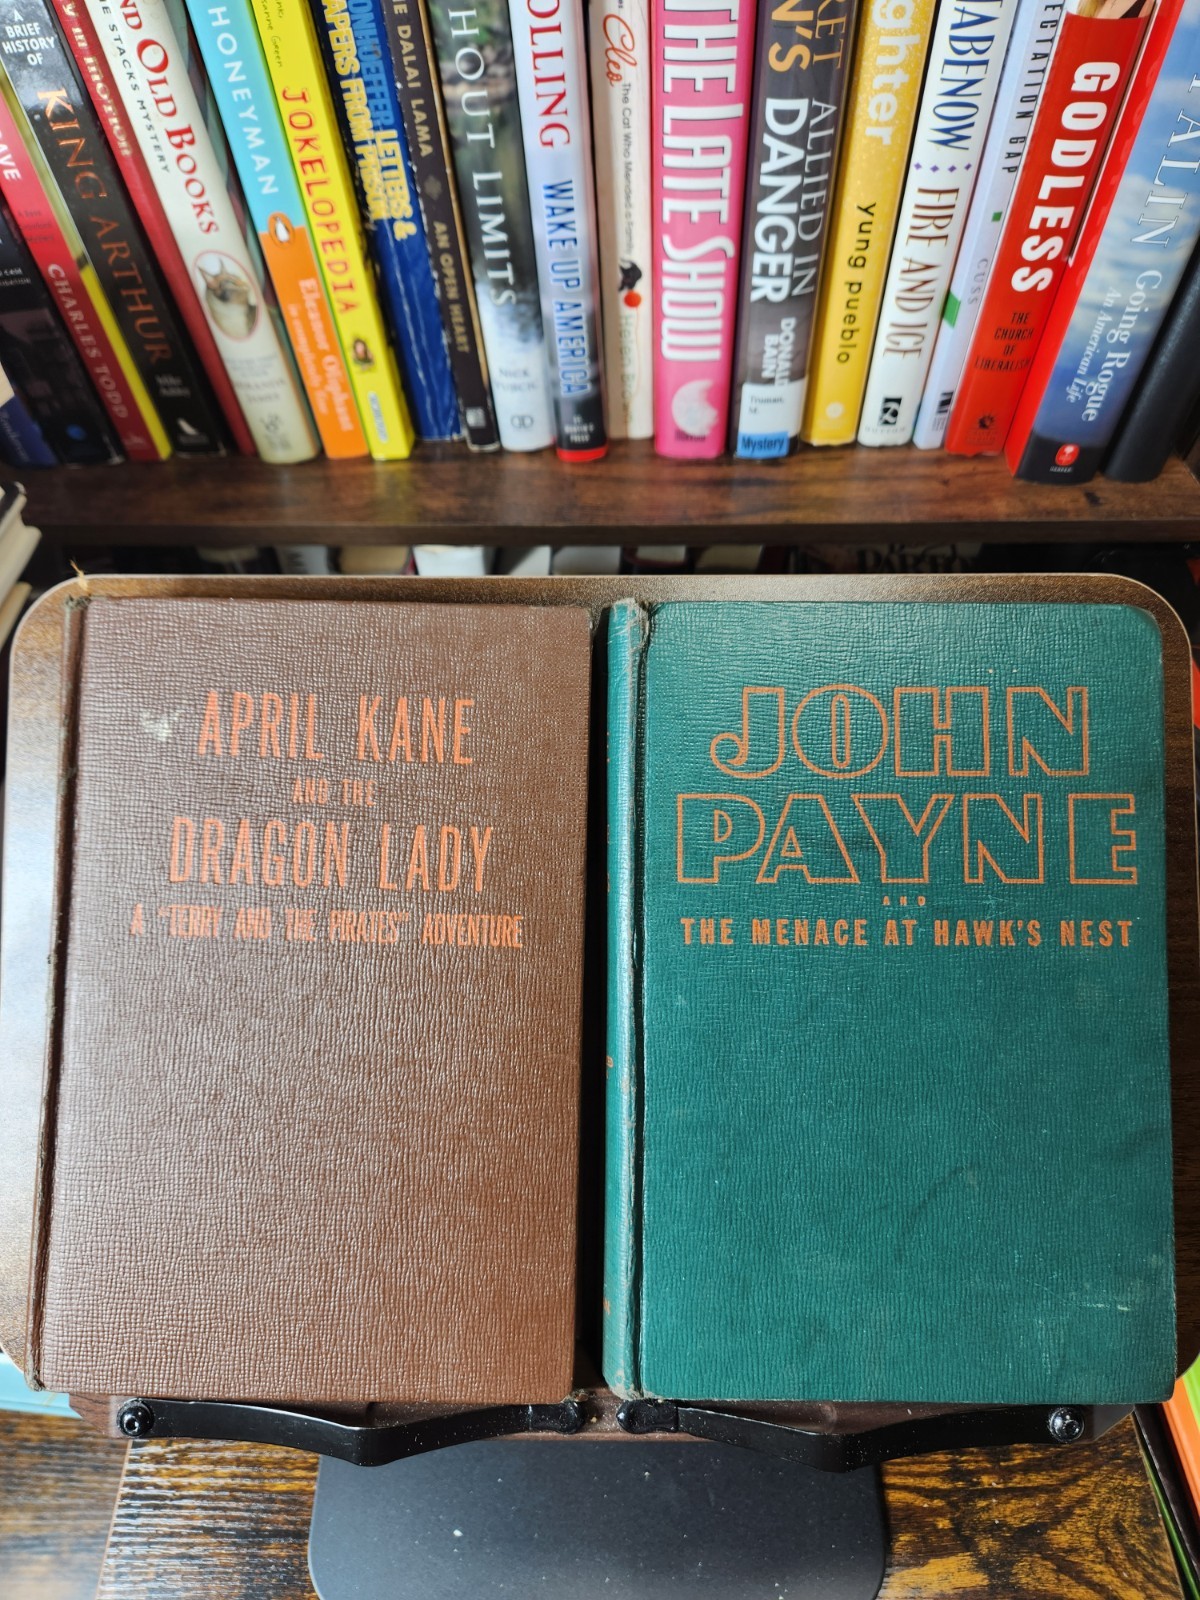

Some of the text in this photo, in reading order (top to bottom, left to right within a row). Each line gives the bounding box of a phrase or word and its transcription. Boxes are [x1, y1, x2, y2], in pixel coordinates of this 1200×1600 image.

[2, 36, 55, 54] HISTORY
[4, 22, 41, 38] BRIEF
[14, 9, 23, 21] A
[26, 53, 43, 66] OF
[270, 35, 283, 67] Green
[397, 24, 421, 89] DALAI
[602, 13, 637, 87] Cleo
[663, 0, 740, 93] THE
[865, 0, 920, 146] ghter
[109, 24, 140, 91] STACKS
[137, 99, 170, 173] MYSTERY
[208, 6, 279, 195] HONEYMAN
[340, 78, 375, 142] FROM
[622, 83, 631, 104] The
[622, 106, 631, 130] Cat
[0, 131, 22, 182] AVE
[136, 38, 177, 117] OLD
[165, 124, 220, 235] BOOKS
[411, 98, 433, 158] LAMA
[448, 8, 517, 306] HOUT LIMITS
[623, 133, 632, 160] Who
[1002, 135, 1028, 173] GAP
[376, 129, 413, 219] LETTERS
[624, 161, 632, 209] Mended
[662, 103, 744, 224] LATE
[1011, 62, 1121, 292] GODLESS
[37, 87, 108, 199] KING
[89, 215, 172, 365] ARTHUR
[282, 88, 358, 314] JOKELOPEDIA
[527, 0, 590, 395] OLLING WAKE UP AMERICA
[750, 98, 809, 303] DANGER
[792, 97, 838, 296] ALLIED IN
[905, 187, 960, 247] FIRE
[393, 220, 417, 241] &
[433, 221, 450, 248] AN
[439, 254, 459, 299] OPEN
[661, 234, 735, 361] SHOW
[837, 202, 877, 364] yung pueblo
[894, 257, 943, 314] AND
[48, 263, 129, 419] CHARLES TODD
[449, 303, 470, 353] HEART
[620, 314, 635, 367] Helen
[882, 322, 928, 359] ICE
[994, 328, 1034, 341] CHURCH
[1011, 312, 1030, 324] THE
[1066, 286, 1122, 403] An American Life
[1081, 269, 1163, 422] Going Rogue
[761, 334, 779, 379] BAIN
[1003, 344, 1017, 356] OF
[741, 436, 785, 454] Mystery
[199, 690, 475, 765] APRIL KANE
[710, 684, 1089, 779] JOHN
[292, 777, 376, 807] AND THE
[170, 816, 494, 893] DRAGON LADY
[677, 793, 1138, 885] PAYNE
[130, 905, 144, 936] A
[233, 908, 271, 940] AND
[286, 909, 316, 942] THE
[422, 913, 523, 949] ADVENTURE
[882, 895, 927, 906] AND
[680, 917, 1132, 948] THE MENACE AT HAWK'S NEST
